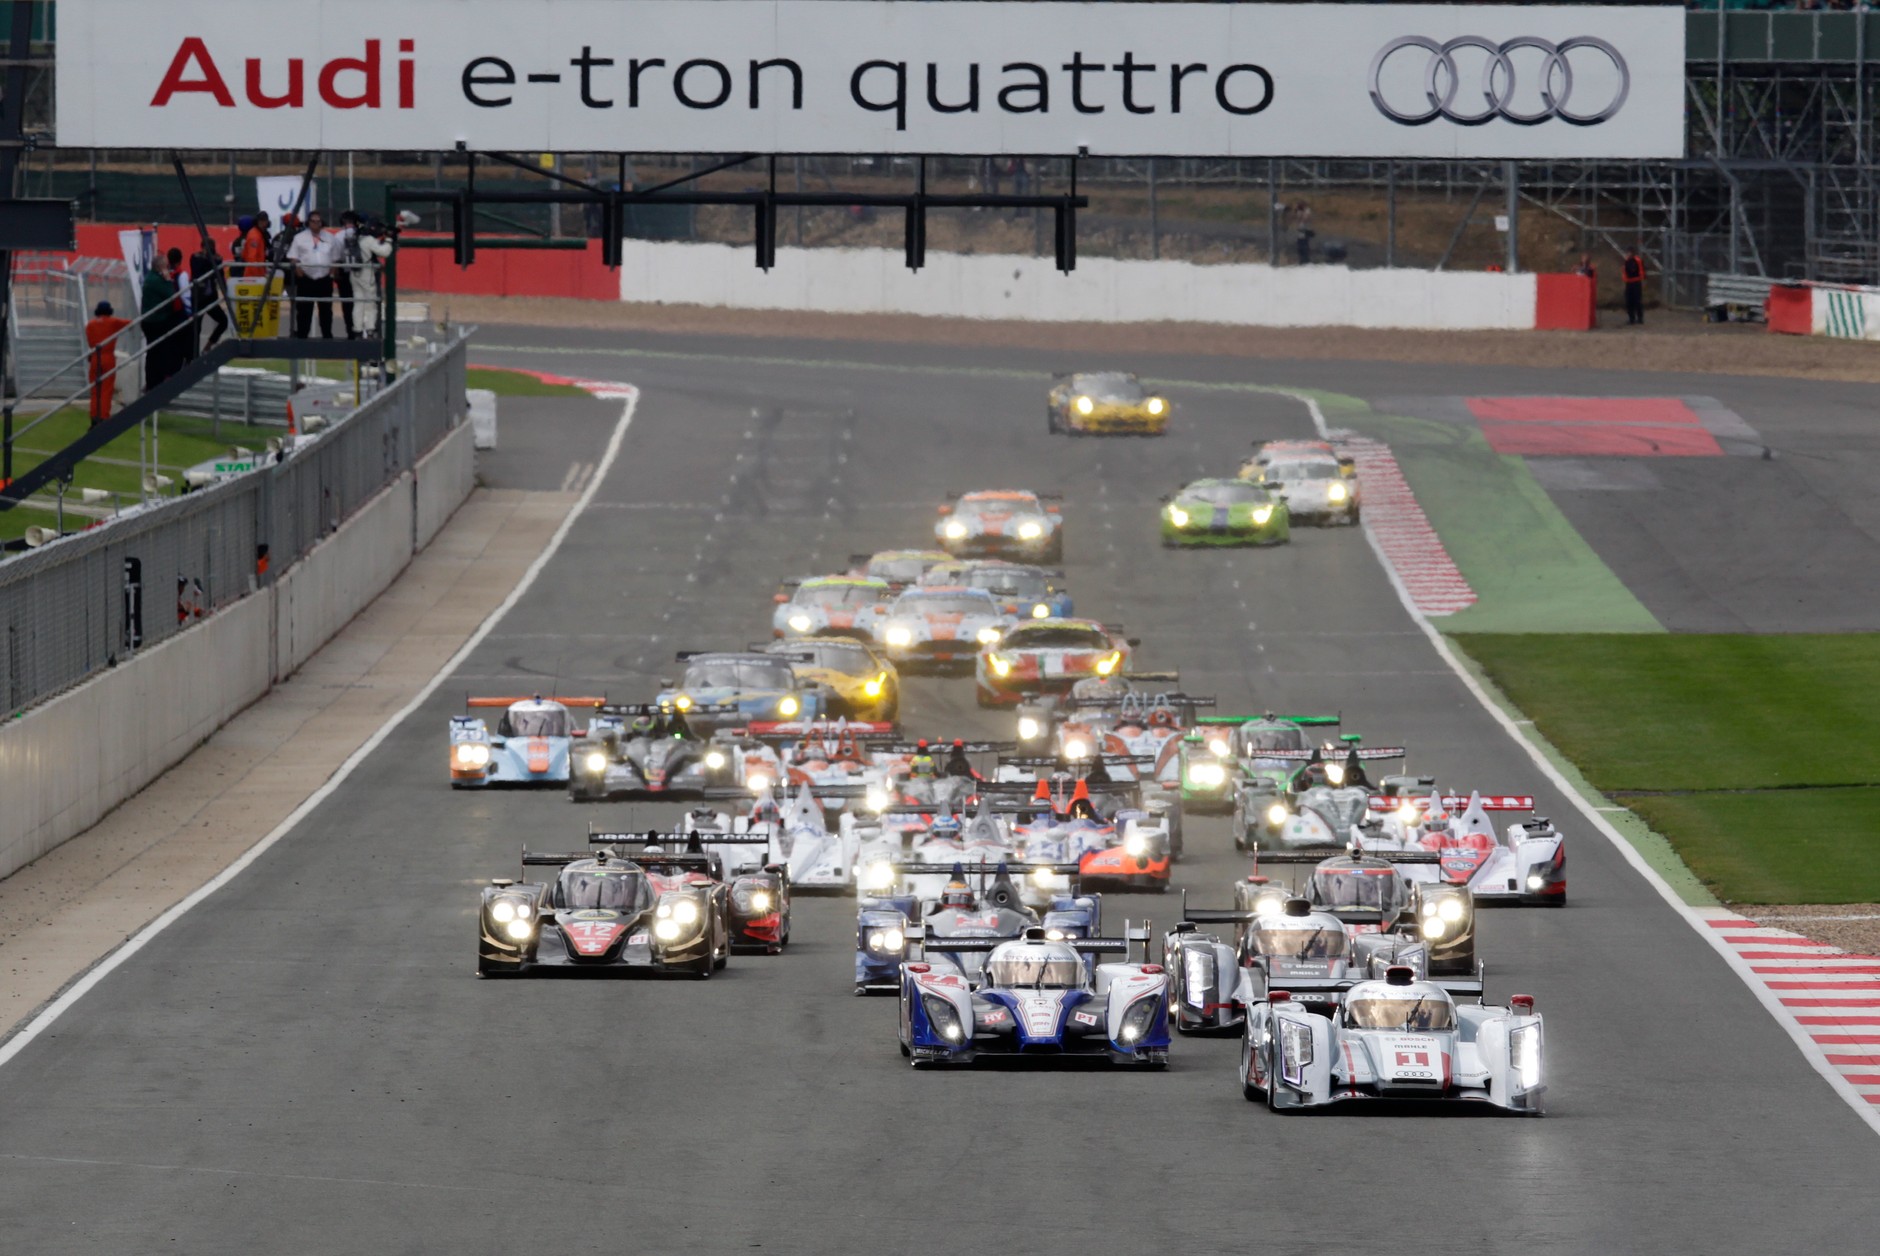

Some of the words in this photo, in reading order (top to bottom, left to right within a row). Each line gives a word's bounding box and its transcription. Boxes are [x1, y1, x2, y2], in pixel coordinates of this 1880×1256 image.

[150, 37, 415, 110] Audi
[461, 45, 804, 111] e-tron
[850, 50, 1275, 132] quattro
[238, 289, 249, 332] DLAYED
[579, 926, 612, 937] 12
[984, 1011, 1004, 1022] HY
[1077, 1013, 1093, 1023] P1
[915, 1047, 950, 1056] MICHELIN
[1400, 1052, 1424, 1066] 1
